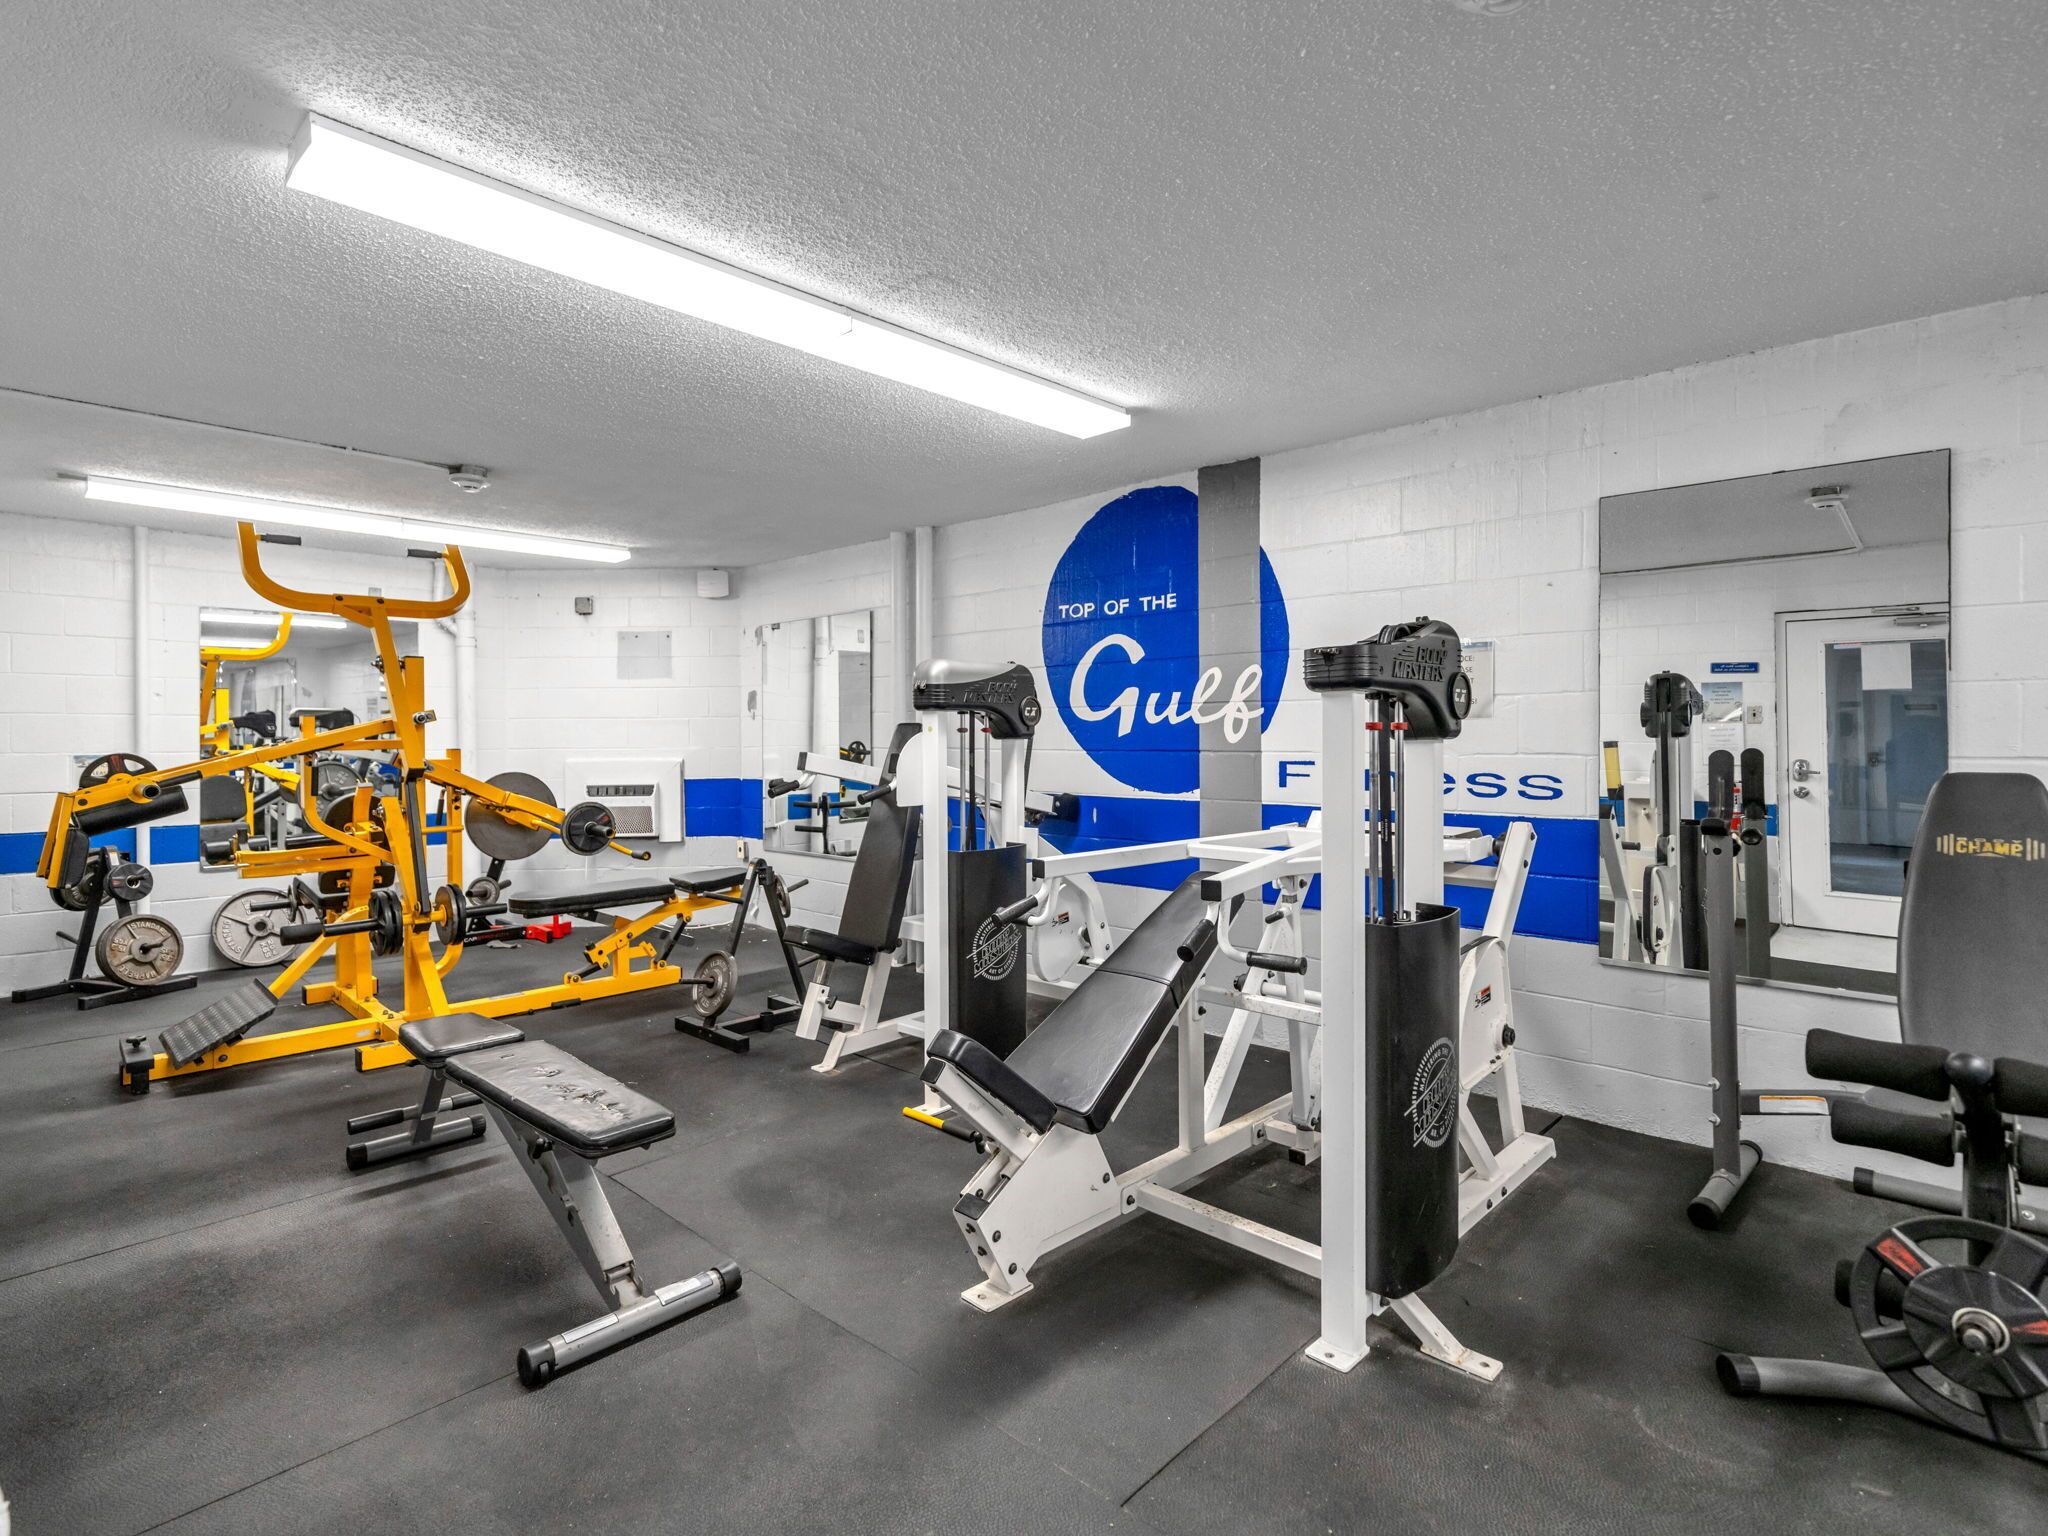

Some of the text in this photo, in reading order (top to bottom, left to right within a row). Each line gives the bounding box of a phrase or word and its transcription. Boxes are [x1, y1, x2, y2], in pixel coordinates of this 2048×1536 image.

[1058, 593, 1177, 618] TOP OF THE
[1415, 646, 1449, 665] BODY
[1391, 659, 1445, 682] MASTERS
[963, 690, 1015, 704] MASTERS
[1069, 633, 1265, 744] Gulf
[1024, 706, 1038, 717] CX
[1955, 839, 2024, 857] CHAMP
[130, 920, 168, 937] STANDARD
